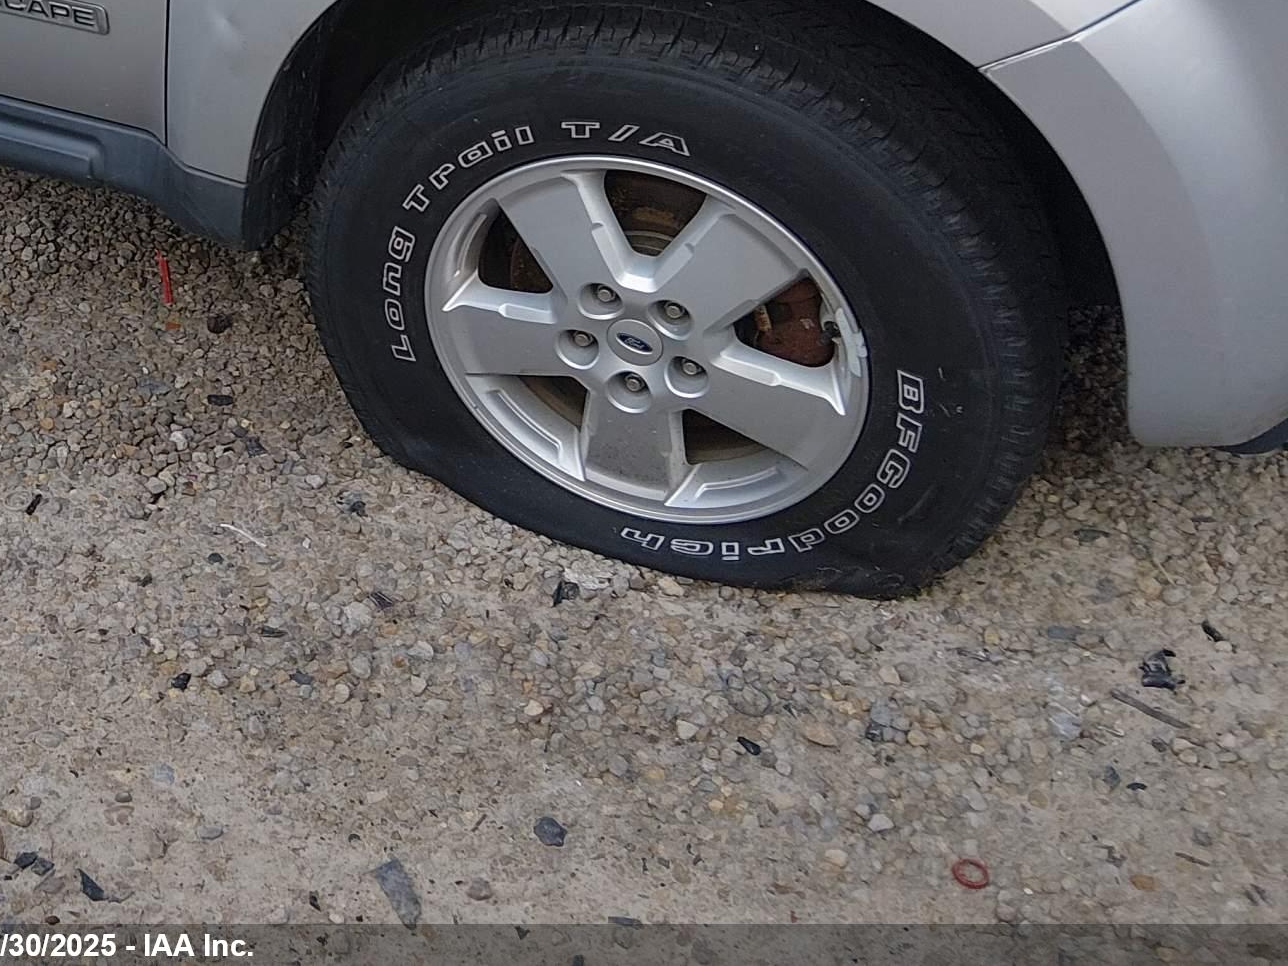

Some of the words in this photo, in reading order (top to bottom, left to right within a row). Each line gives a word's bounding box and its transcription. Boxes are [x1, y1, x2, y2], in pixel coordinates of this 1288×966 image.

[382, 225, 417, 362] Long
[402, 124, 535, 213] Trail
[560, 120, 691, 157] T/A
[620, 369, 925, 561] BFGoodrich
